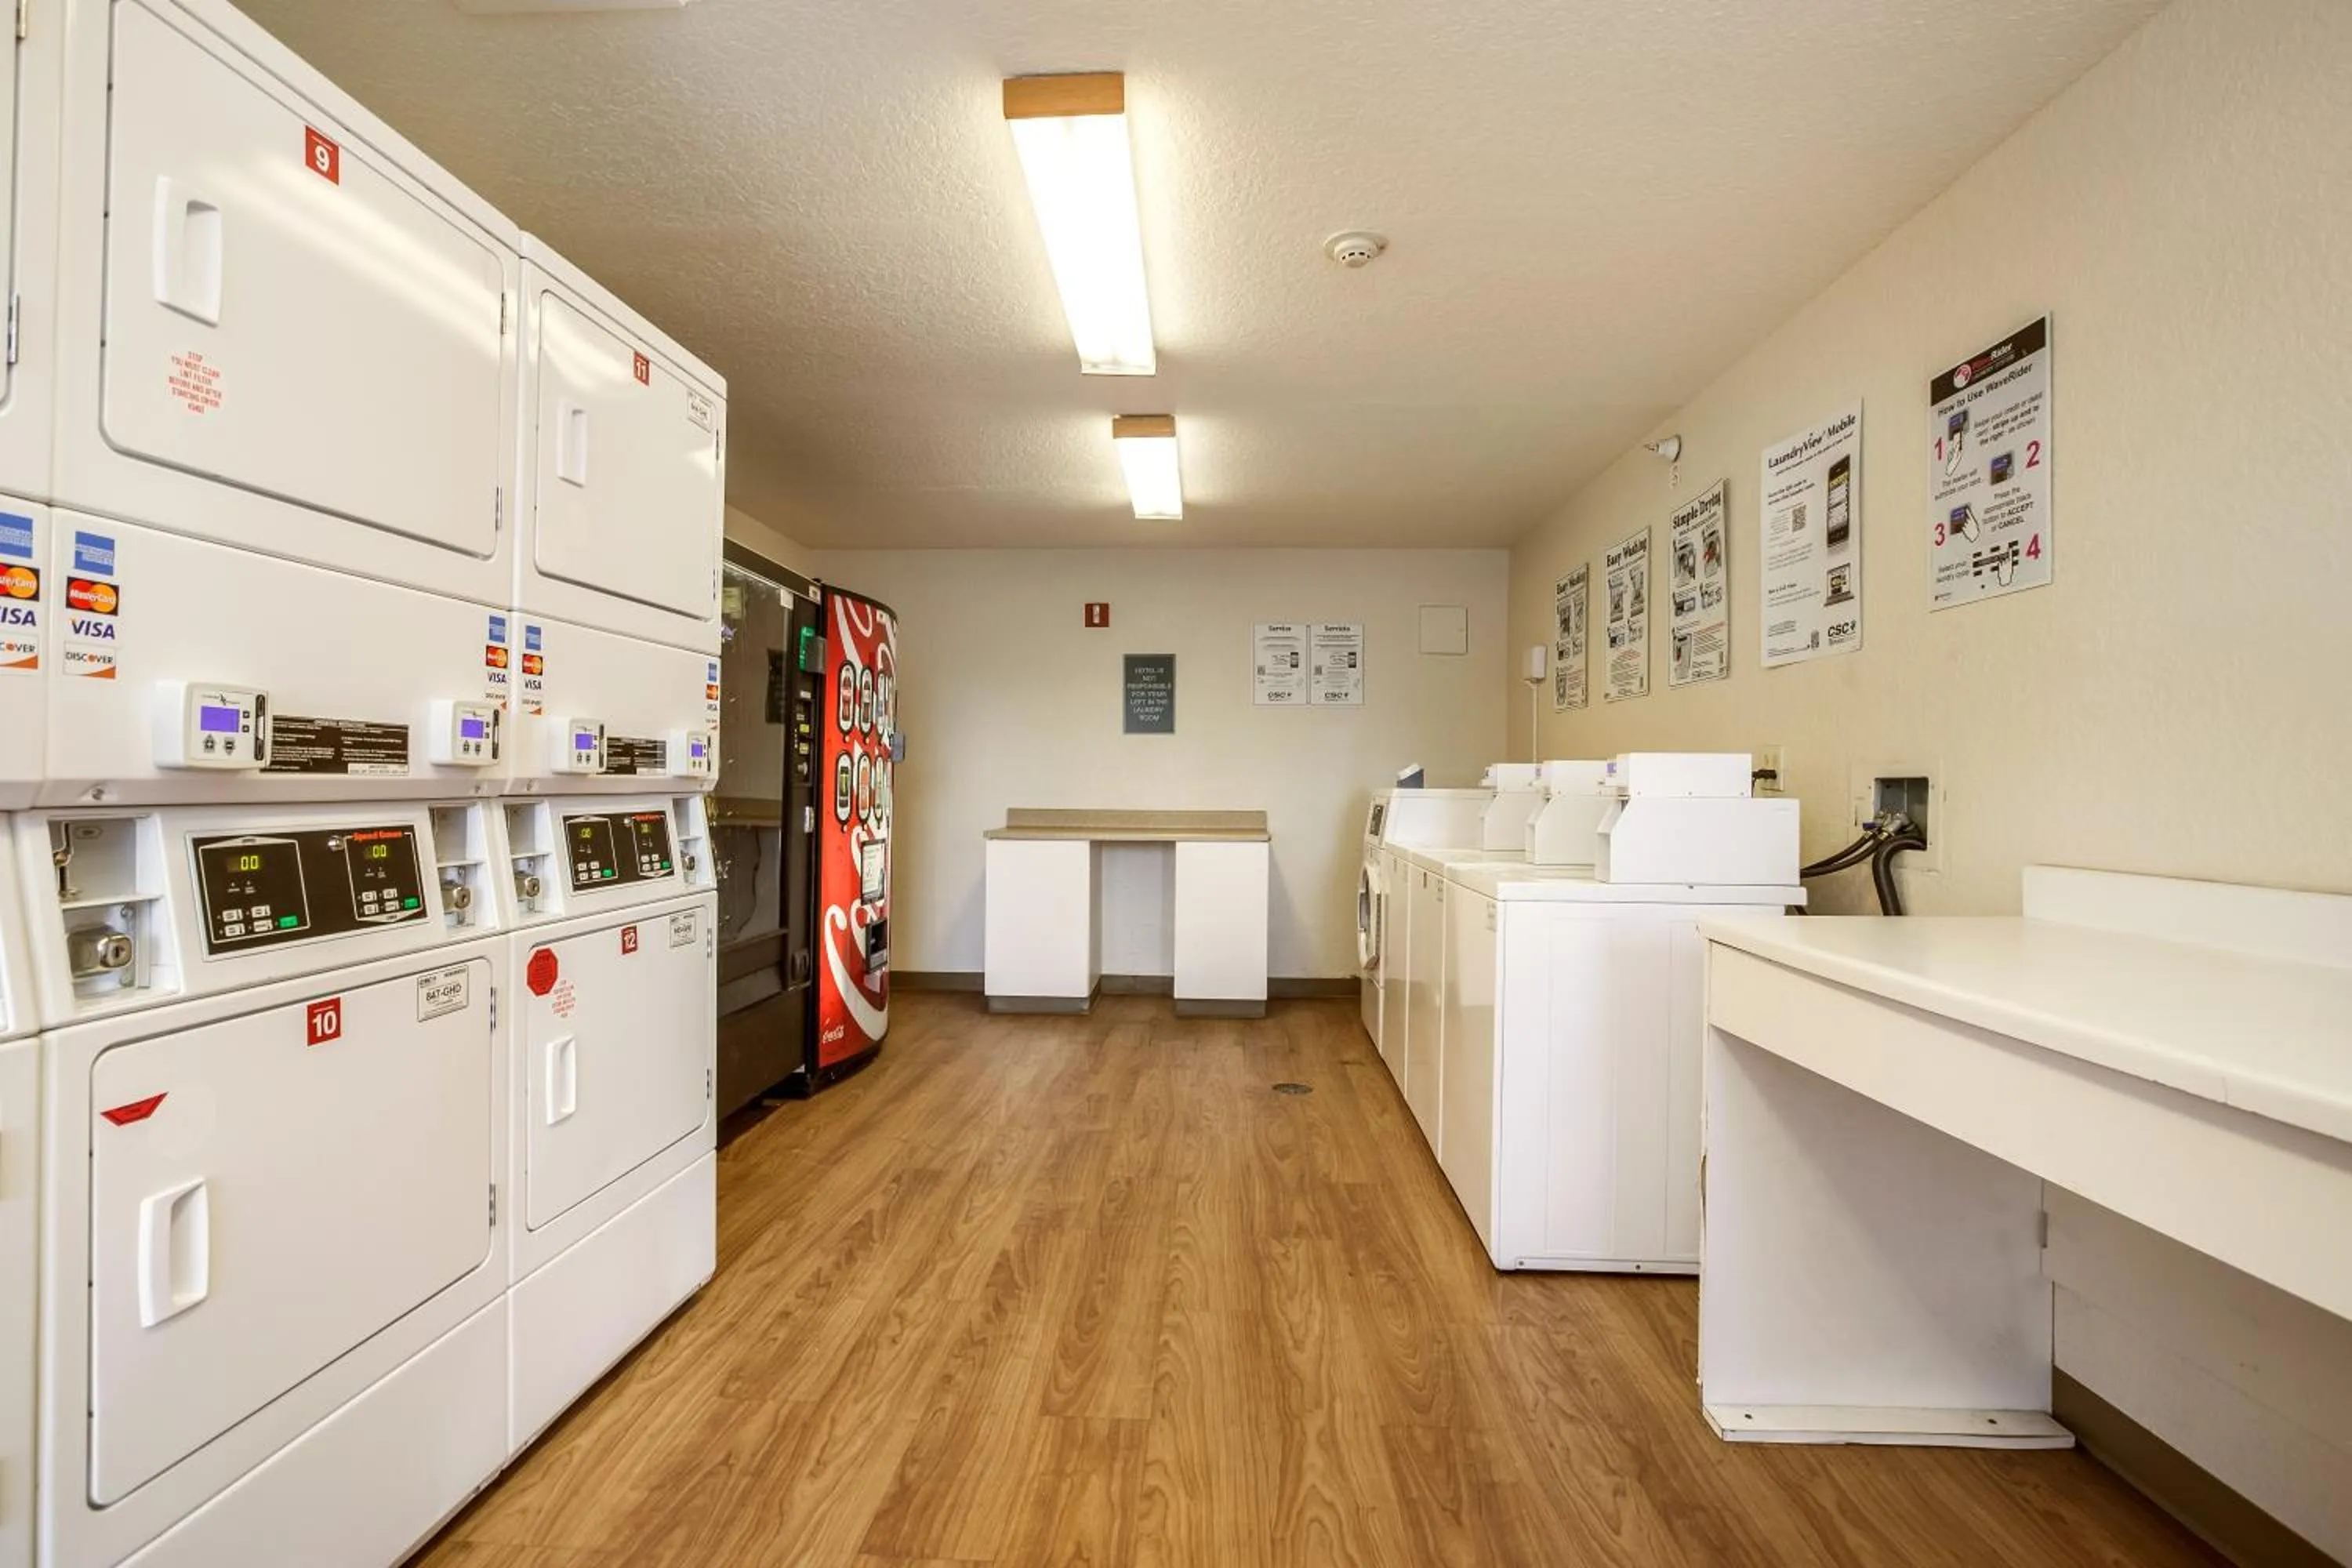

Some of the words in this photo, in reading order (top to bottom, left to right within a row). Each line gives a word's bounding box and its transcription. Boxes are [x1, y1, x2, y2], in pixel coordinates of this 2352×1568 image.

[314, 145, 329, 173] 9
[636, 361, 647, 380] 11
[1938, 403, 1954, 416] How
[1967, 389, 1984, 402] Use
[1985, 363, 2033, 394] WaveRider
[1828, 414, 1856, 437] Mobile
[1934, 437, 1943, 461] 1
[2026, 440, 2041, 468] 2
[1672, 504, 1699, 529] Simple
[2007, 501, 2034, 517] ACCEPT
[1998, 516, 2025, 529] CANCEL
[1934, 523, 1945, 546] 3
[2026, 534, 2041, 559] 4
[1606, 551, 1621, 567] Easy
[70, 589, 115, 603] MasterCard
[0, 605, 36, 626] ISA
[71, 619, 115, 640] VISA
[1828, 622, 1849, 637] CSC
[65, 652, 114, 664] DISCOVER
[488, 672, 507, 684] VISA
[524, 679, 542, 690] VISA
[372, 844, 387, 858] 00
[241, 855, 259, 871] 00
[624, 933, 636, 949] 12
[312, 1011, 336, 1036] 10
